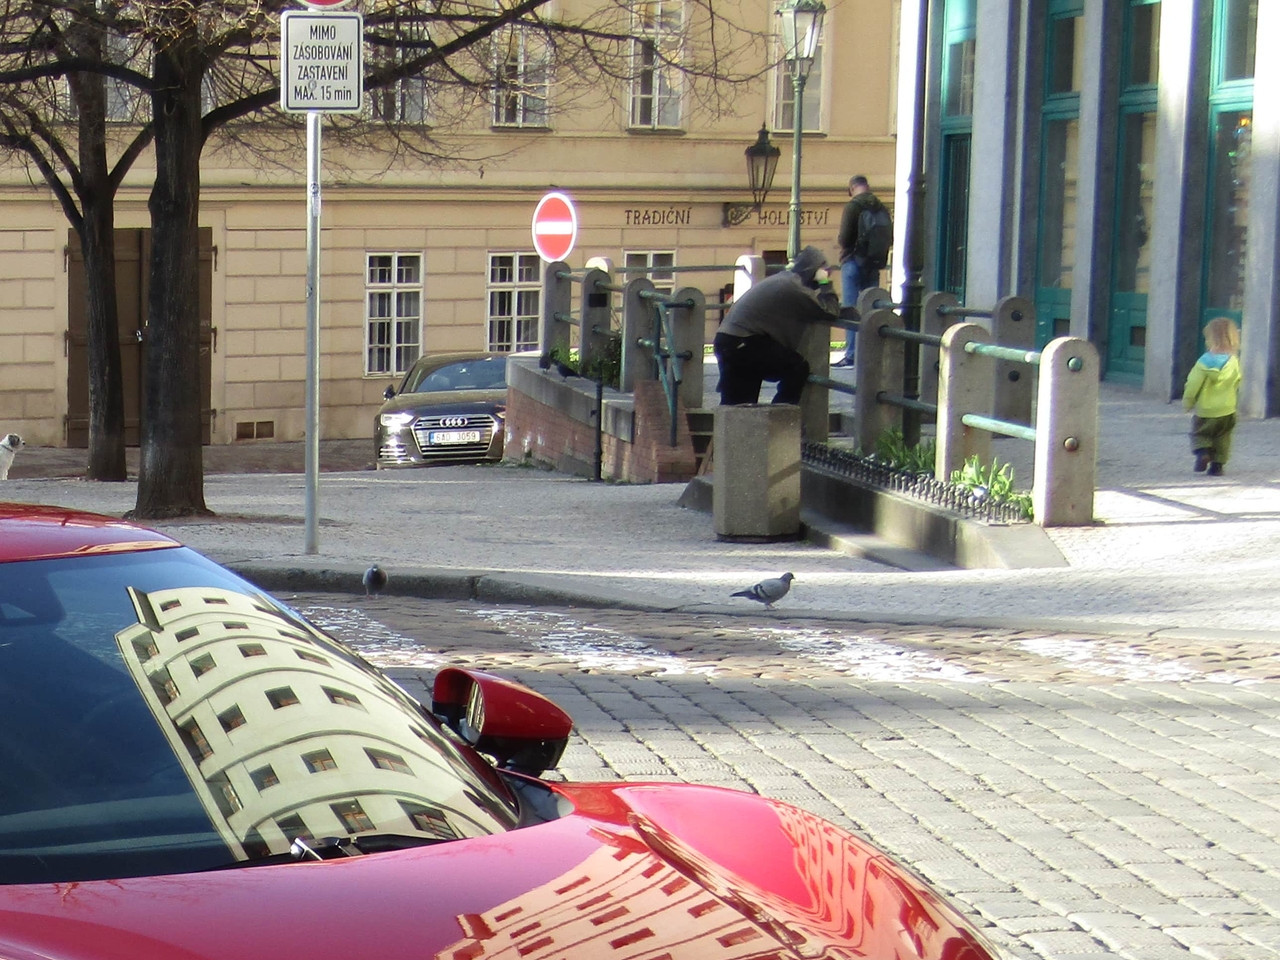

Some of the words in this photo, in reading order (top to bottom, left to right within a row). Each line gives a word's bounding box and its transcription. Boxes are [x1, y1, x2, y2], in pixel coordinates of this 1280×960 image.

[309, 25, 336, 40] MIMO
[293, 42, 353, 60] ZÁSOBOVÁNÍ
[297, 62, 349, 80] ZASTAVENÍ
[294, 85, 318, 100] MAX.
[321, 85, 332, 100] 15
[334, 86, 352, 100] min
[624, 206, 693, 225] TRADIČNÍ
[757, 208, 830, 225] HOLISTVÍ
[456, 431, 477, 441] 3059
